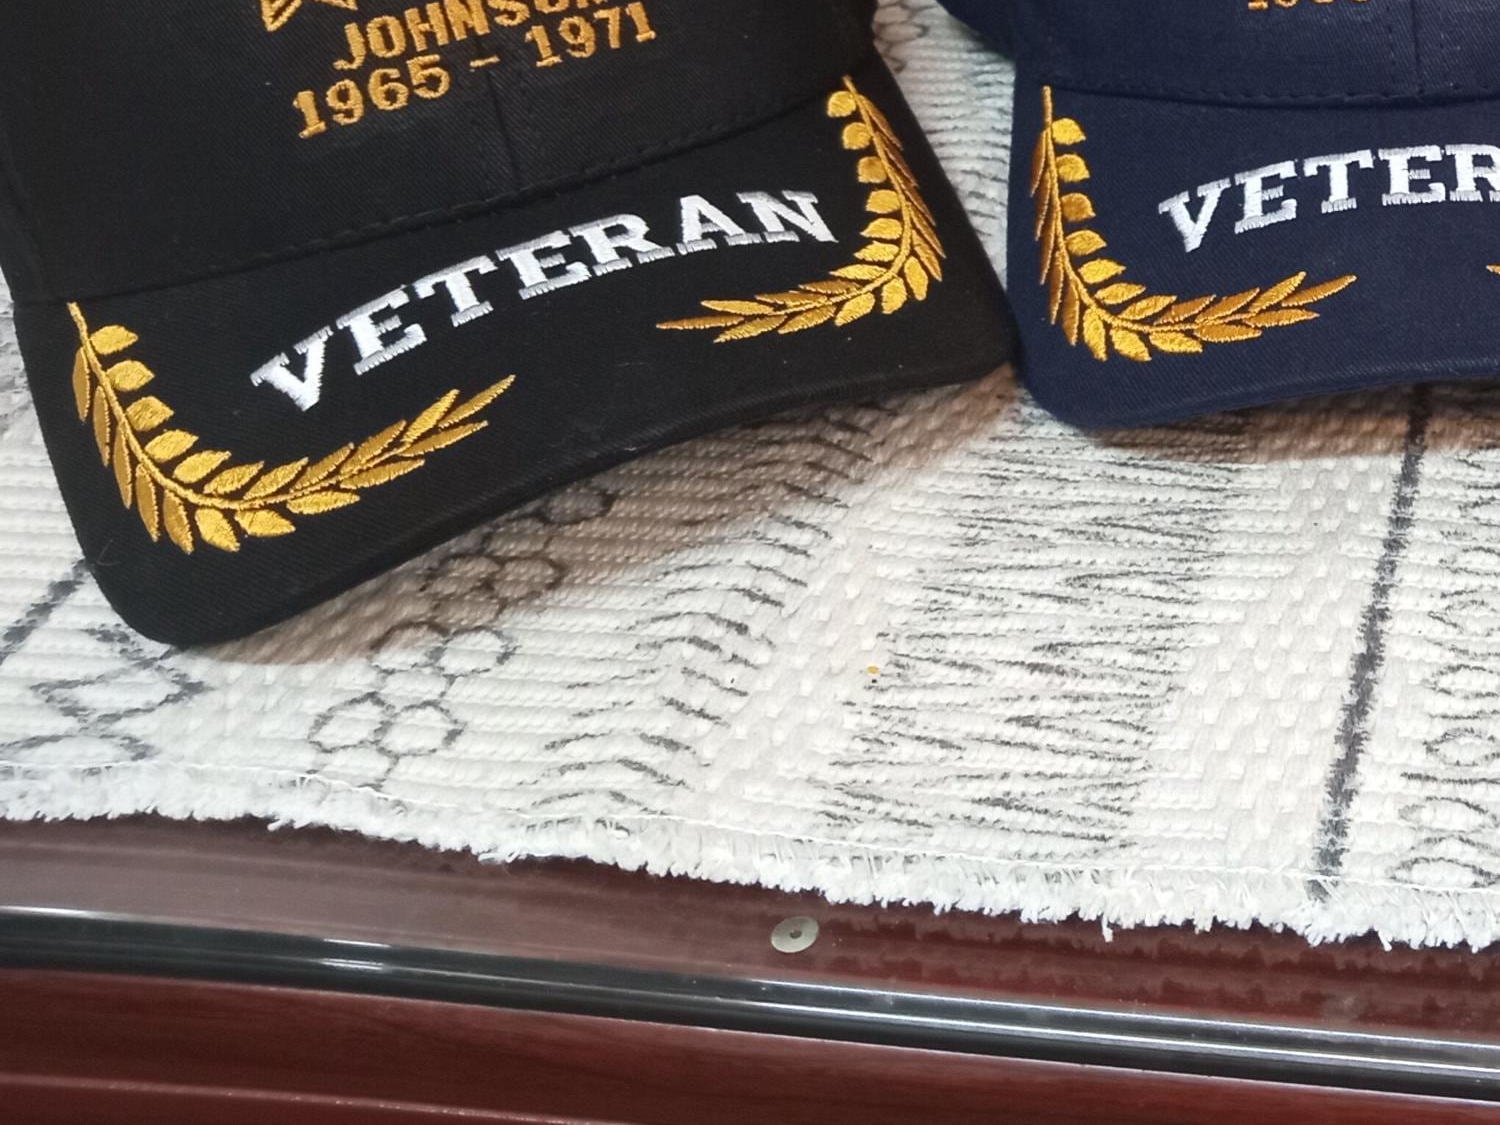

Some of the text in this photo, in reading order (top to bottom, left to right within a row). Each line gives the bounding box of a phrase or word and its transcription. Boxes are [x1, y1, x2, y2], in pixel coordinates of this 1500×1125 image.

[292, 54, 450, 139] 1965
[524, 1, 657, 68] 1971
[250, 190, 838, 412] VETERAN
